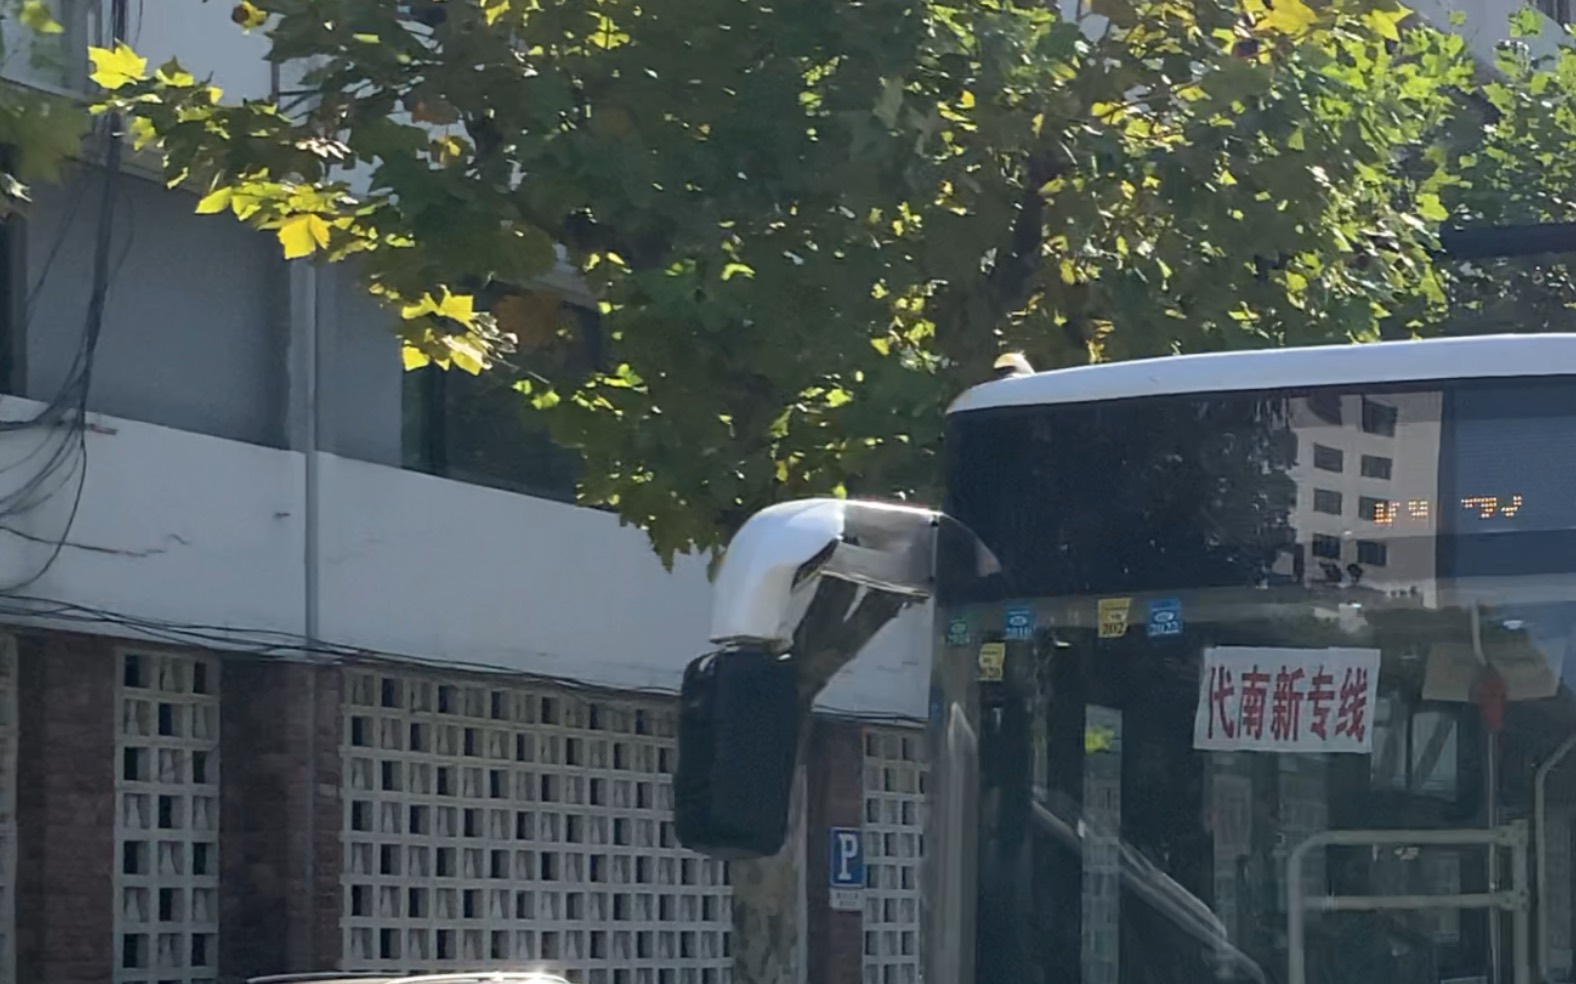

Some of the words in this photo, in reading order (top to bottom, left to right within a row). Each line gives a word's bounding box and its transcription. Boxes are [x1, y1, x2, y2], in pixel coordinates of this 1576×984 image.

[1207, 664, 1368, 742] 代南新专线
[838, 833, 858, 880] P
